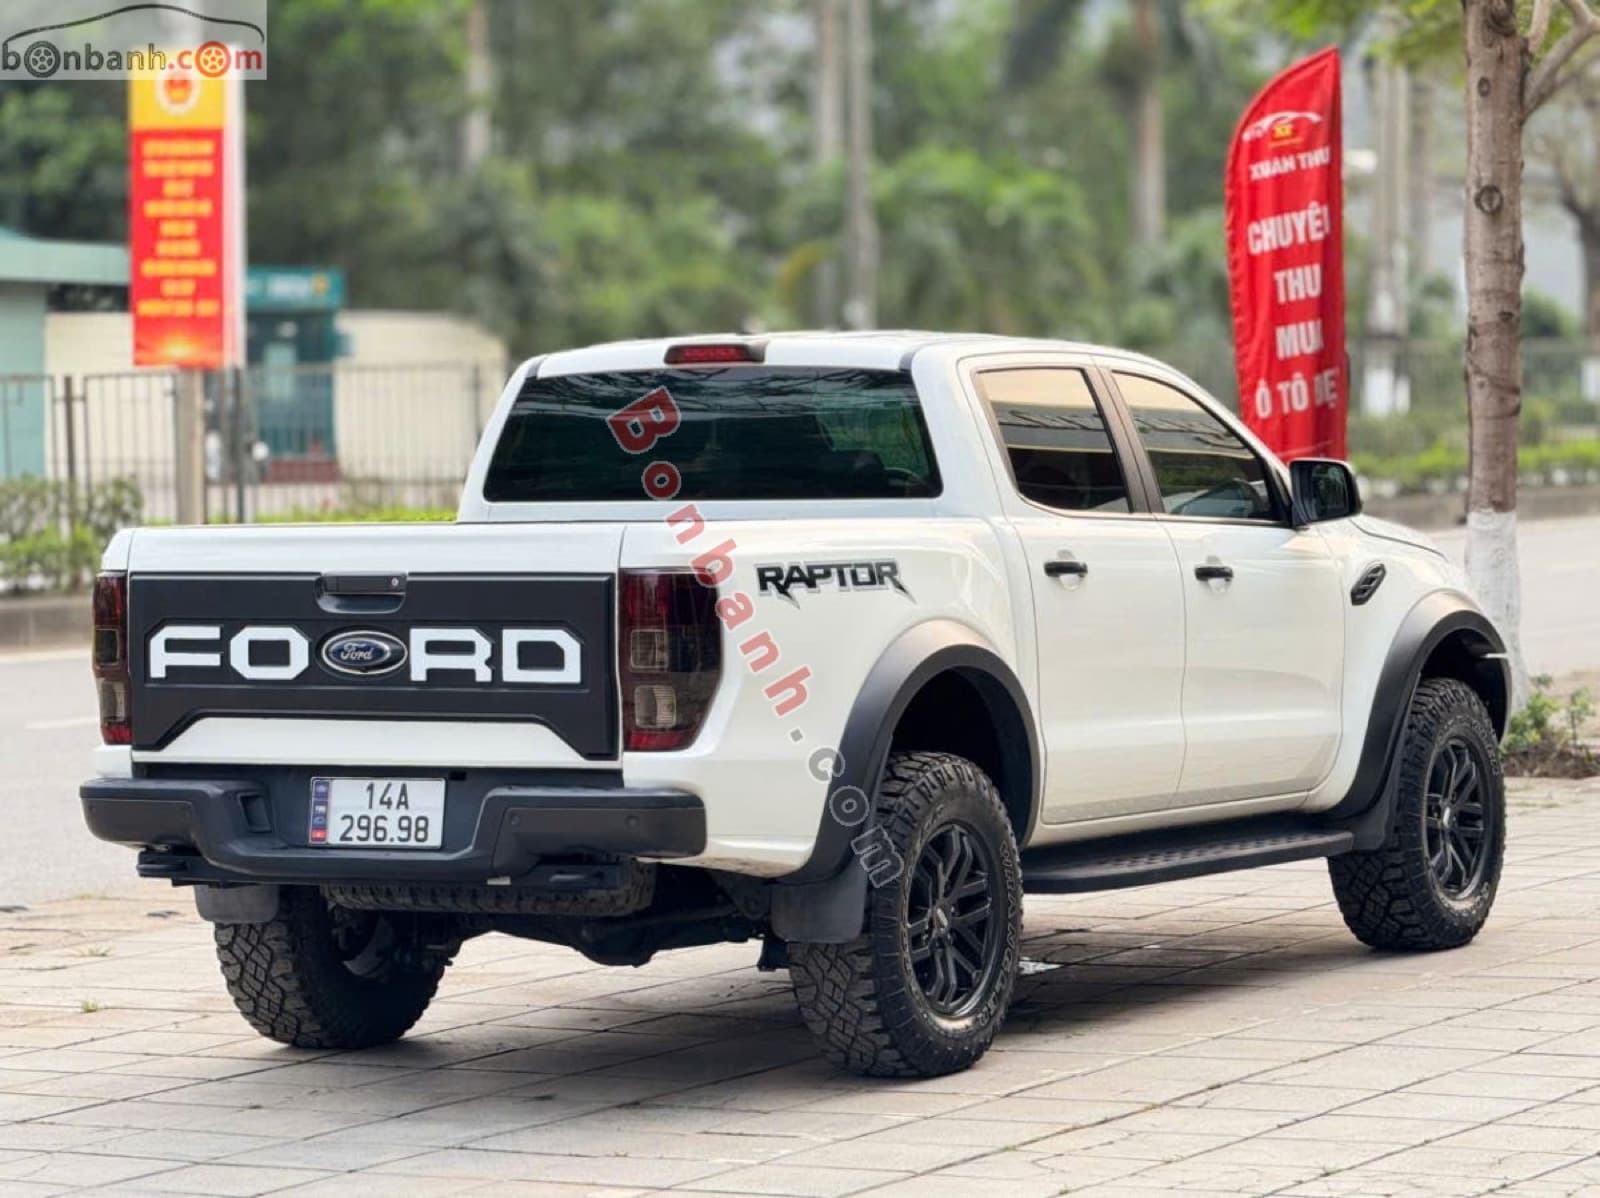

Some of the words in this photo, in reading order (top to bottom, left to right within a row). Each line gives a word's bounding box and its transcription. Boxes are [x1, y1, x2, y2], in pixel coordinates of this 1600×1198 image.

[1274, 262, 1322, 304] THU
[1255, 378, 1272, 419] Ô
[1277, 371, 1309, 414] TÔ
[754, 558, 917, 610] RAPTOR
[340, 642, 375, 661] Ford
[366, 782, 409, 810] 14A
[339, 814, 430, 843] 296.98
